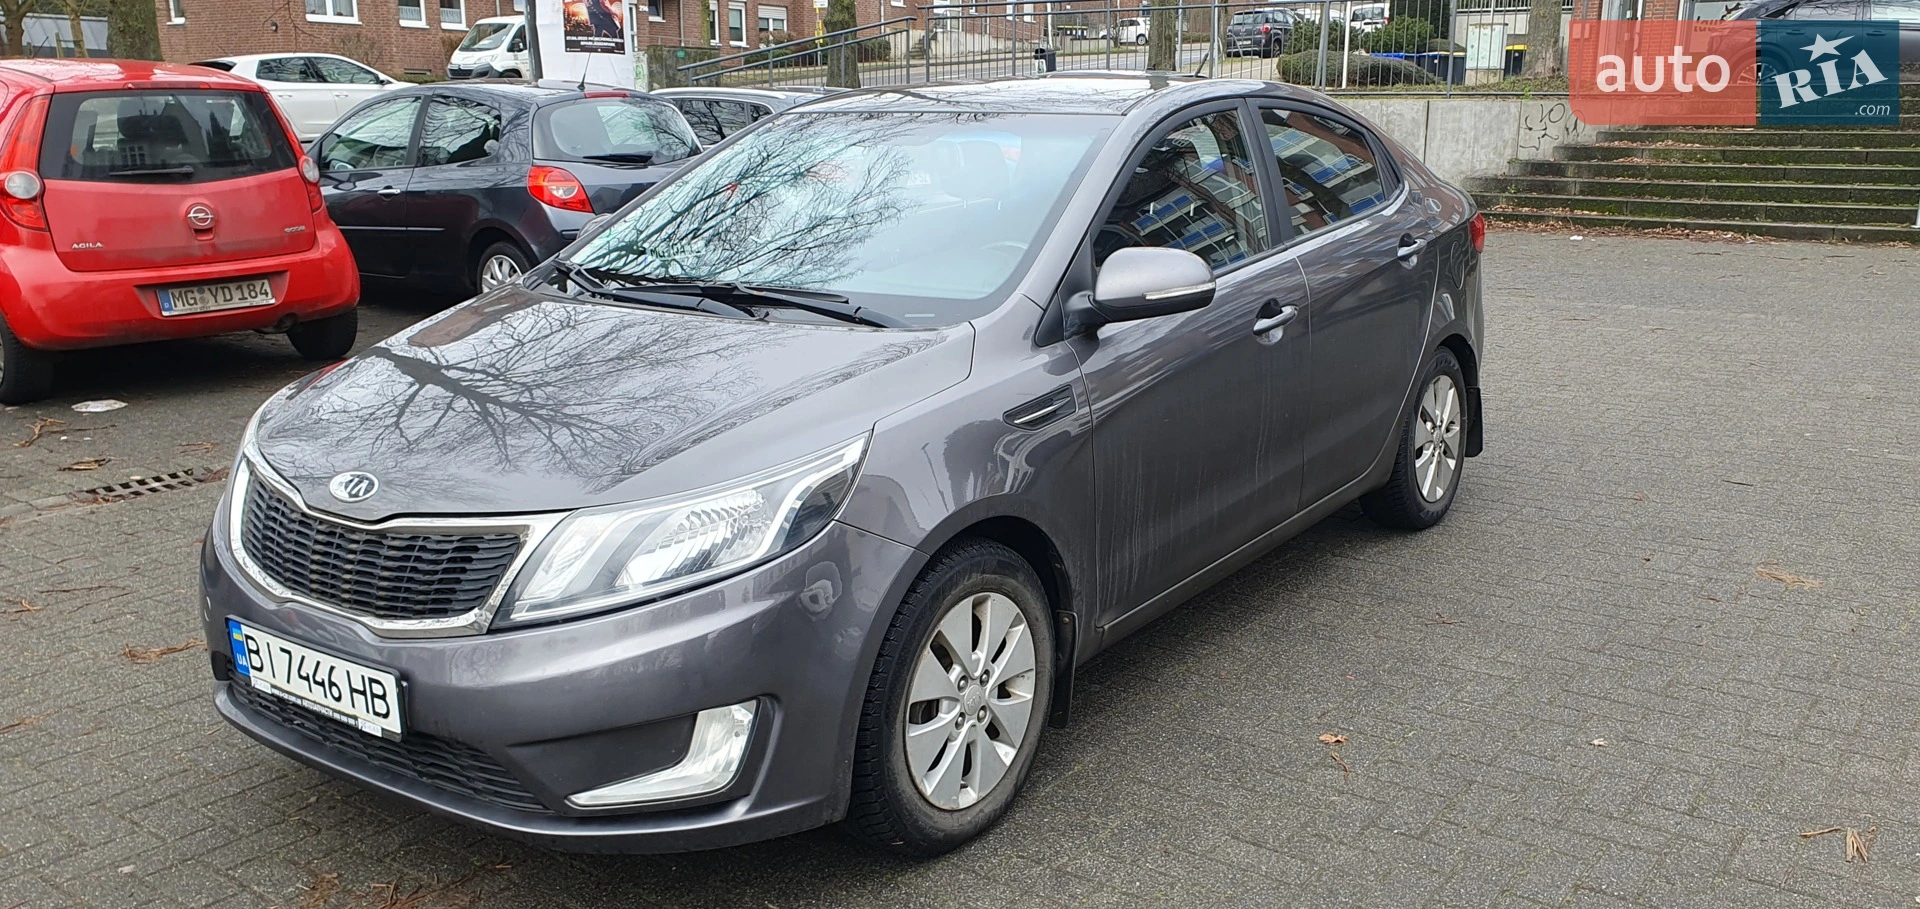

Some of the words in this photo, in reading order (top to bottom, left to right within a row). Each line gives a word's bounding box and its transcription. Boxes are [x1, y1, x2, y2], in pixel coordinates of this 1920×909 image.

[71, 241, 103, 250] AGILA
[170, 289, 198, 309] MG
[207, 285, 234, 304] YD
[235, 281, 270, 302] 184
[236, 654, 249, 668] UA
[279, 646, 342, 703] 7446
[346, 669, 390, 719] HB
